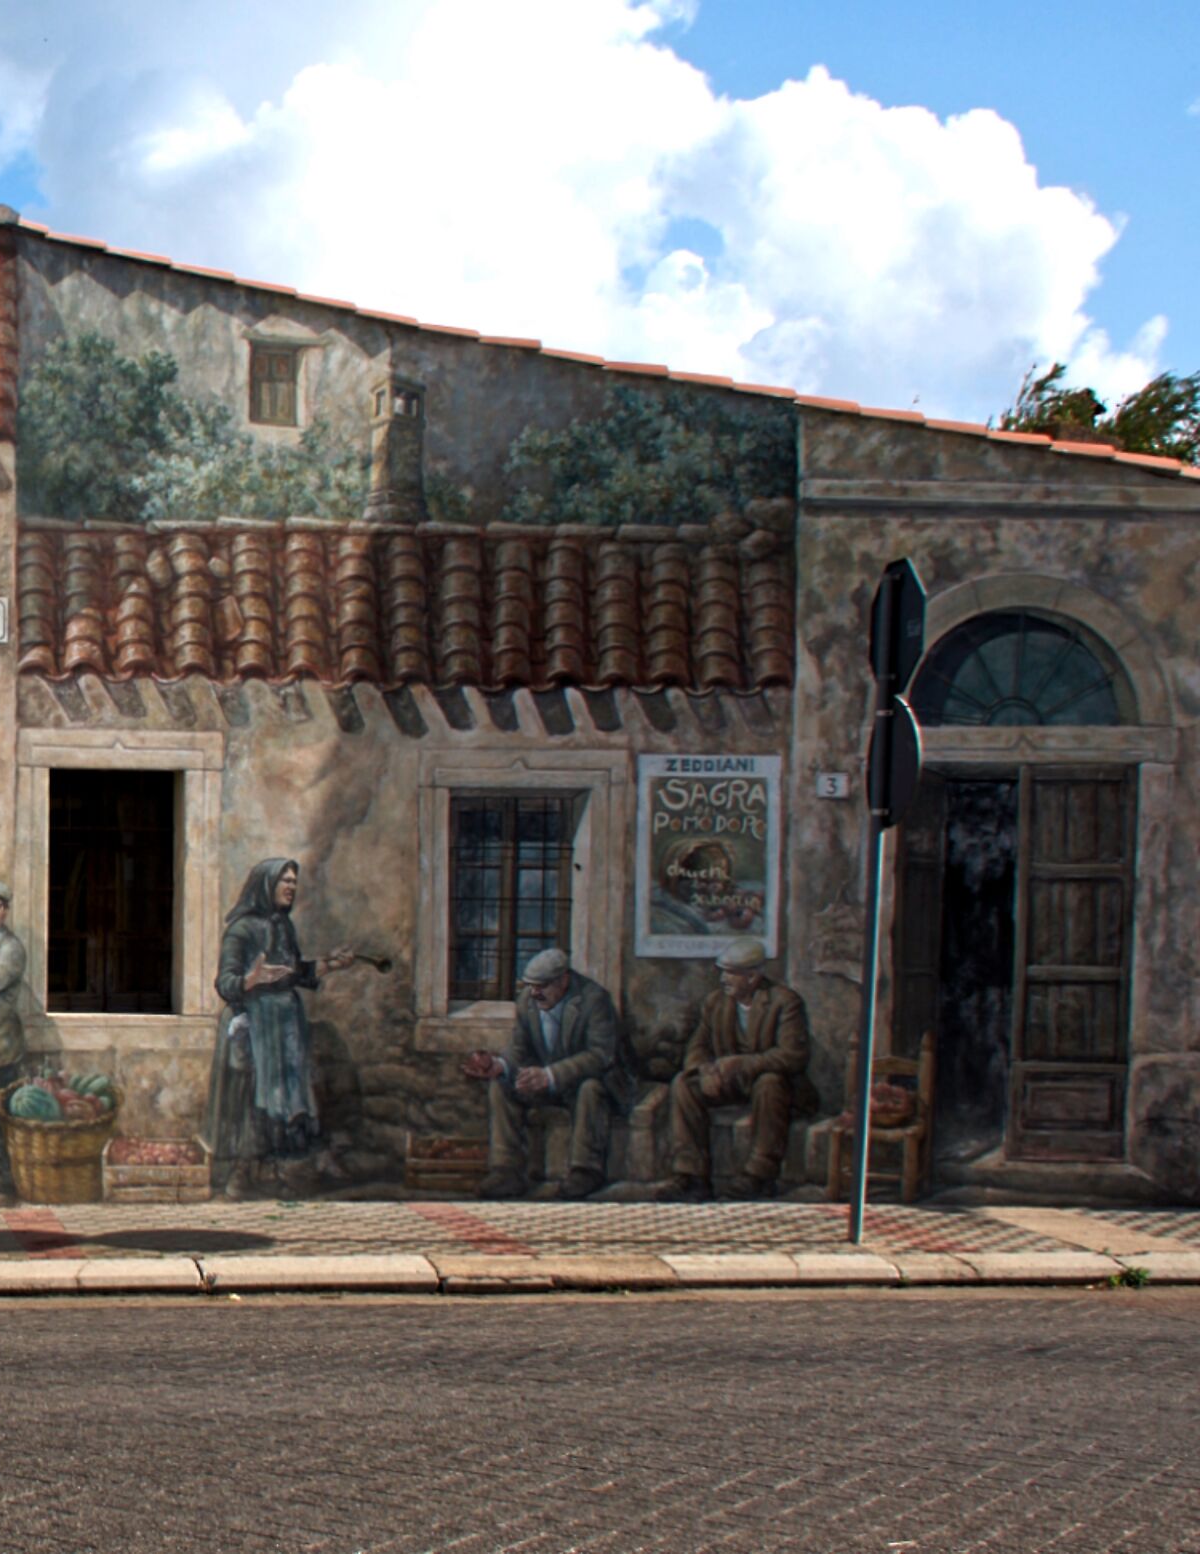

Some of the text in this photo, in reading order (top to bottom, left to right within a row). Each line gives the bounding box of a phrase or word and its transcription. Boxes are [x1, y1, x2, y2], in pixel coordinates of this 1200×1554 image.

[665, 758, 755, 773] ZEDDIANI
[825, 777, 837, 795] 3
[657, 778, 767, 814] SAGRA
